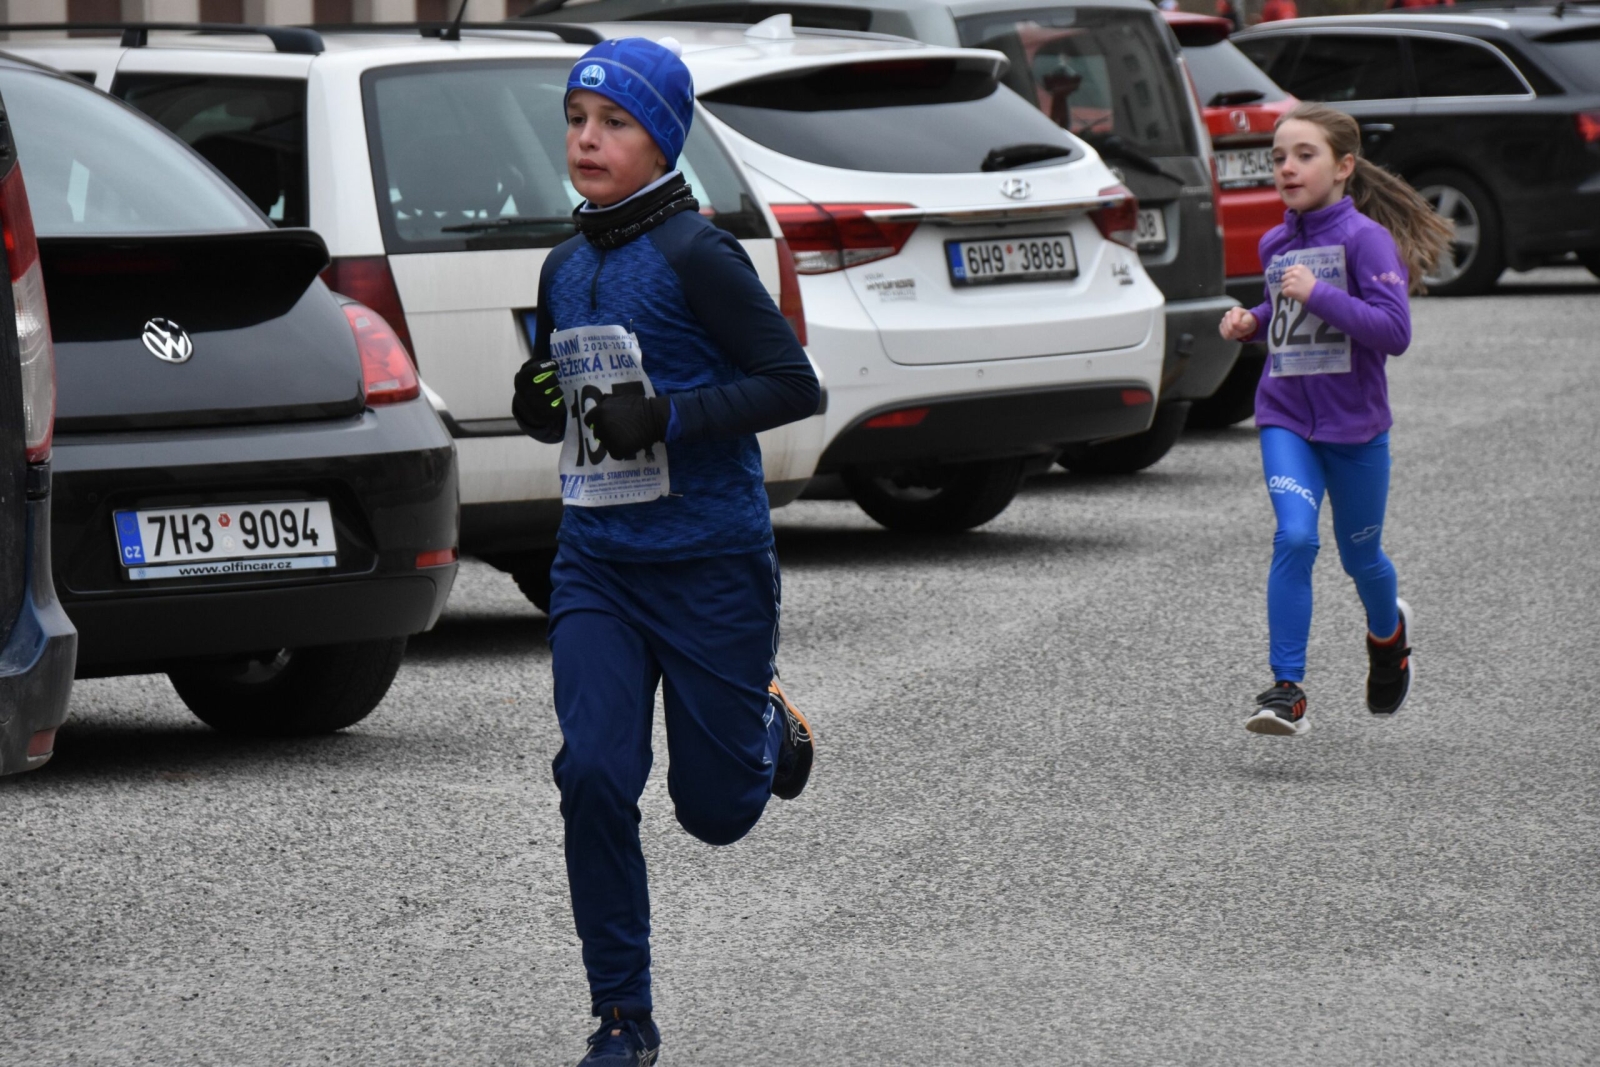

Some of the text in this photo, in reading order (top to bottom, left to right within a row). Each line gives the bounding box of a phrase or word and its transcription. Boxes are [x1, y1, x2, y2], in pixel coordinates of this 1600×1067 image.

[967, 241, 1066, 274] 6H9 3889
[609, 354, 638, 370] LIGA
[571, 381, 650, 467] 13
[147, 508, 319, 557] 7H3 9094
[125, 546, 142, 558] CZ
[179, 560, 293, 576] www.olfincar.cz
